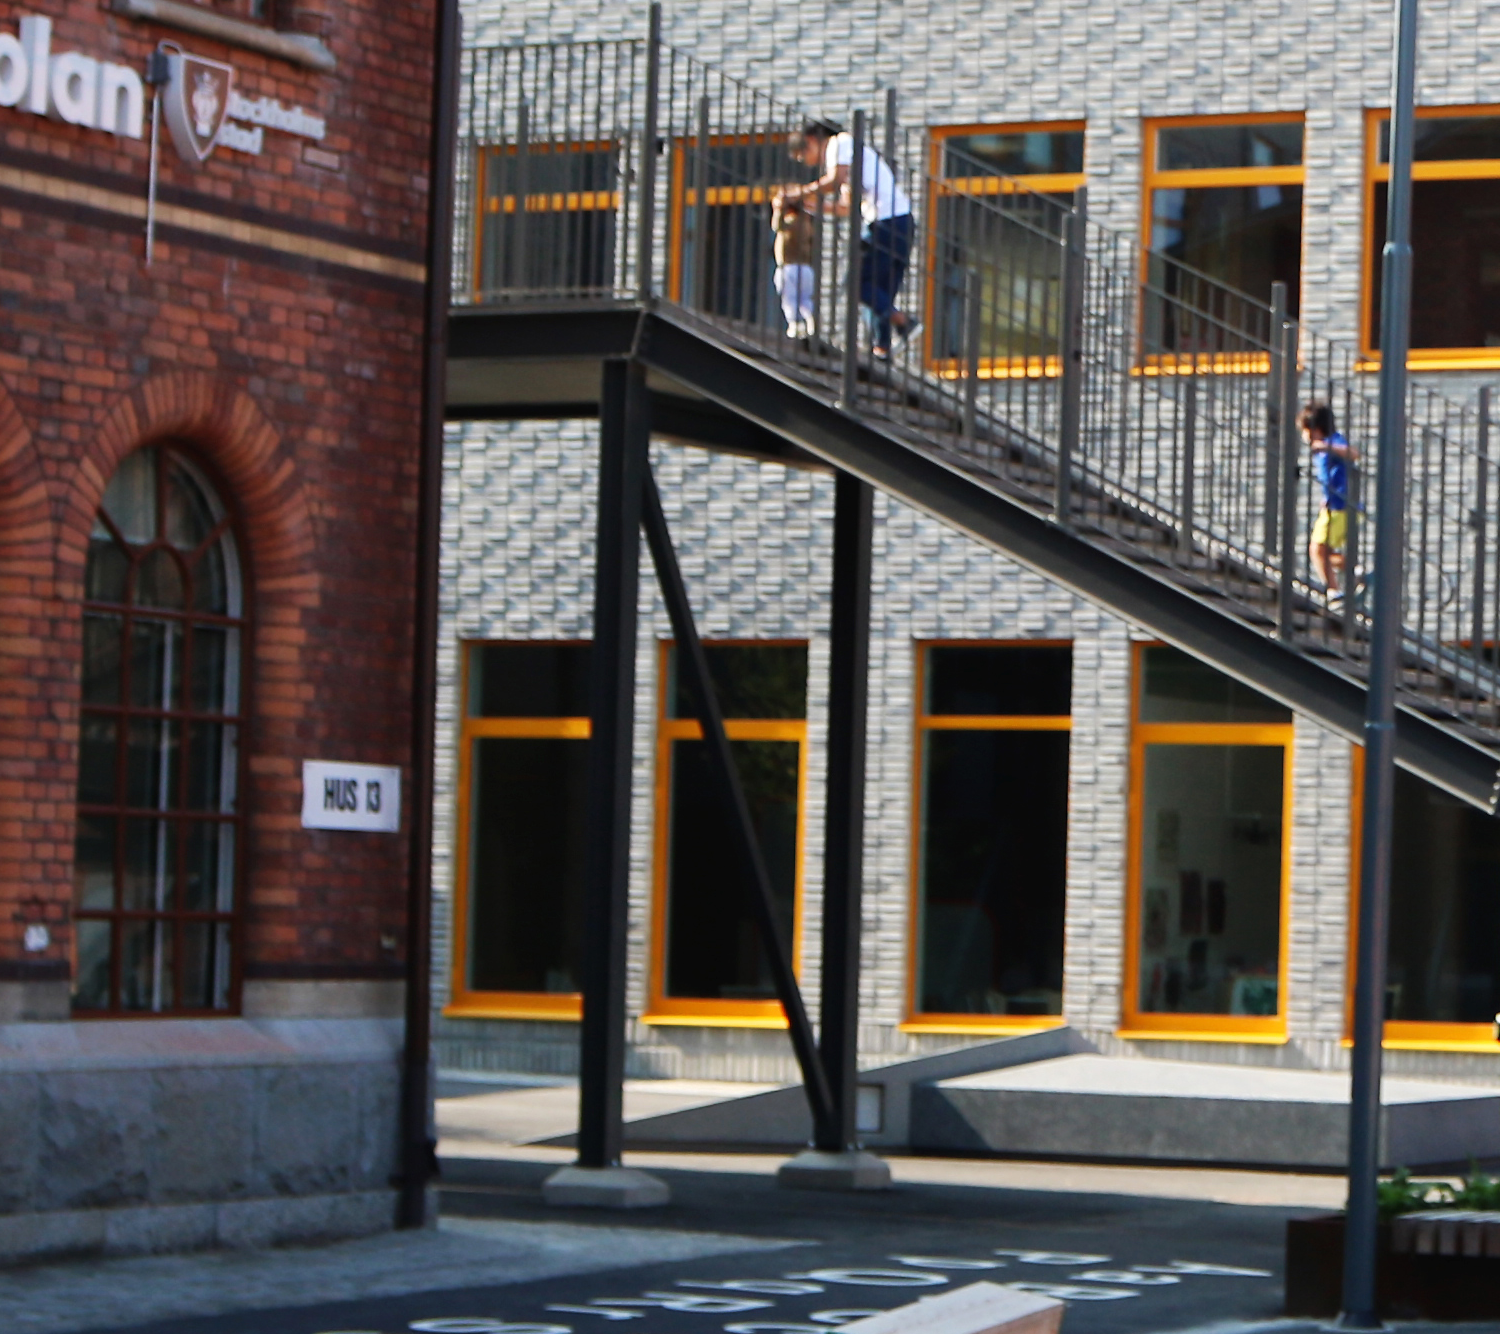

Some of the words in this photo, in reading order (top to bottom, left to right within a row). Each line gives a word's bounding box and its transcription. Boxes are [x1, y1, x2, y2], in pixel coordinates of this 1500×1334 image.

[226, 90, 327, 141] tockholms
[323, 777, 358, 812] HUS
[365, 780, 382, 813] 13
